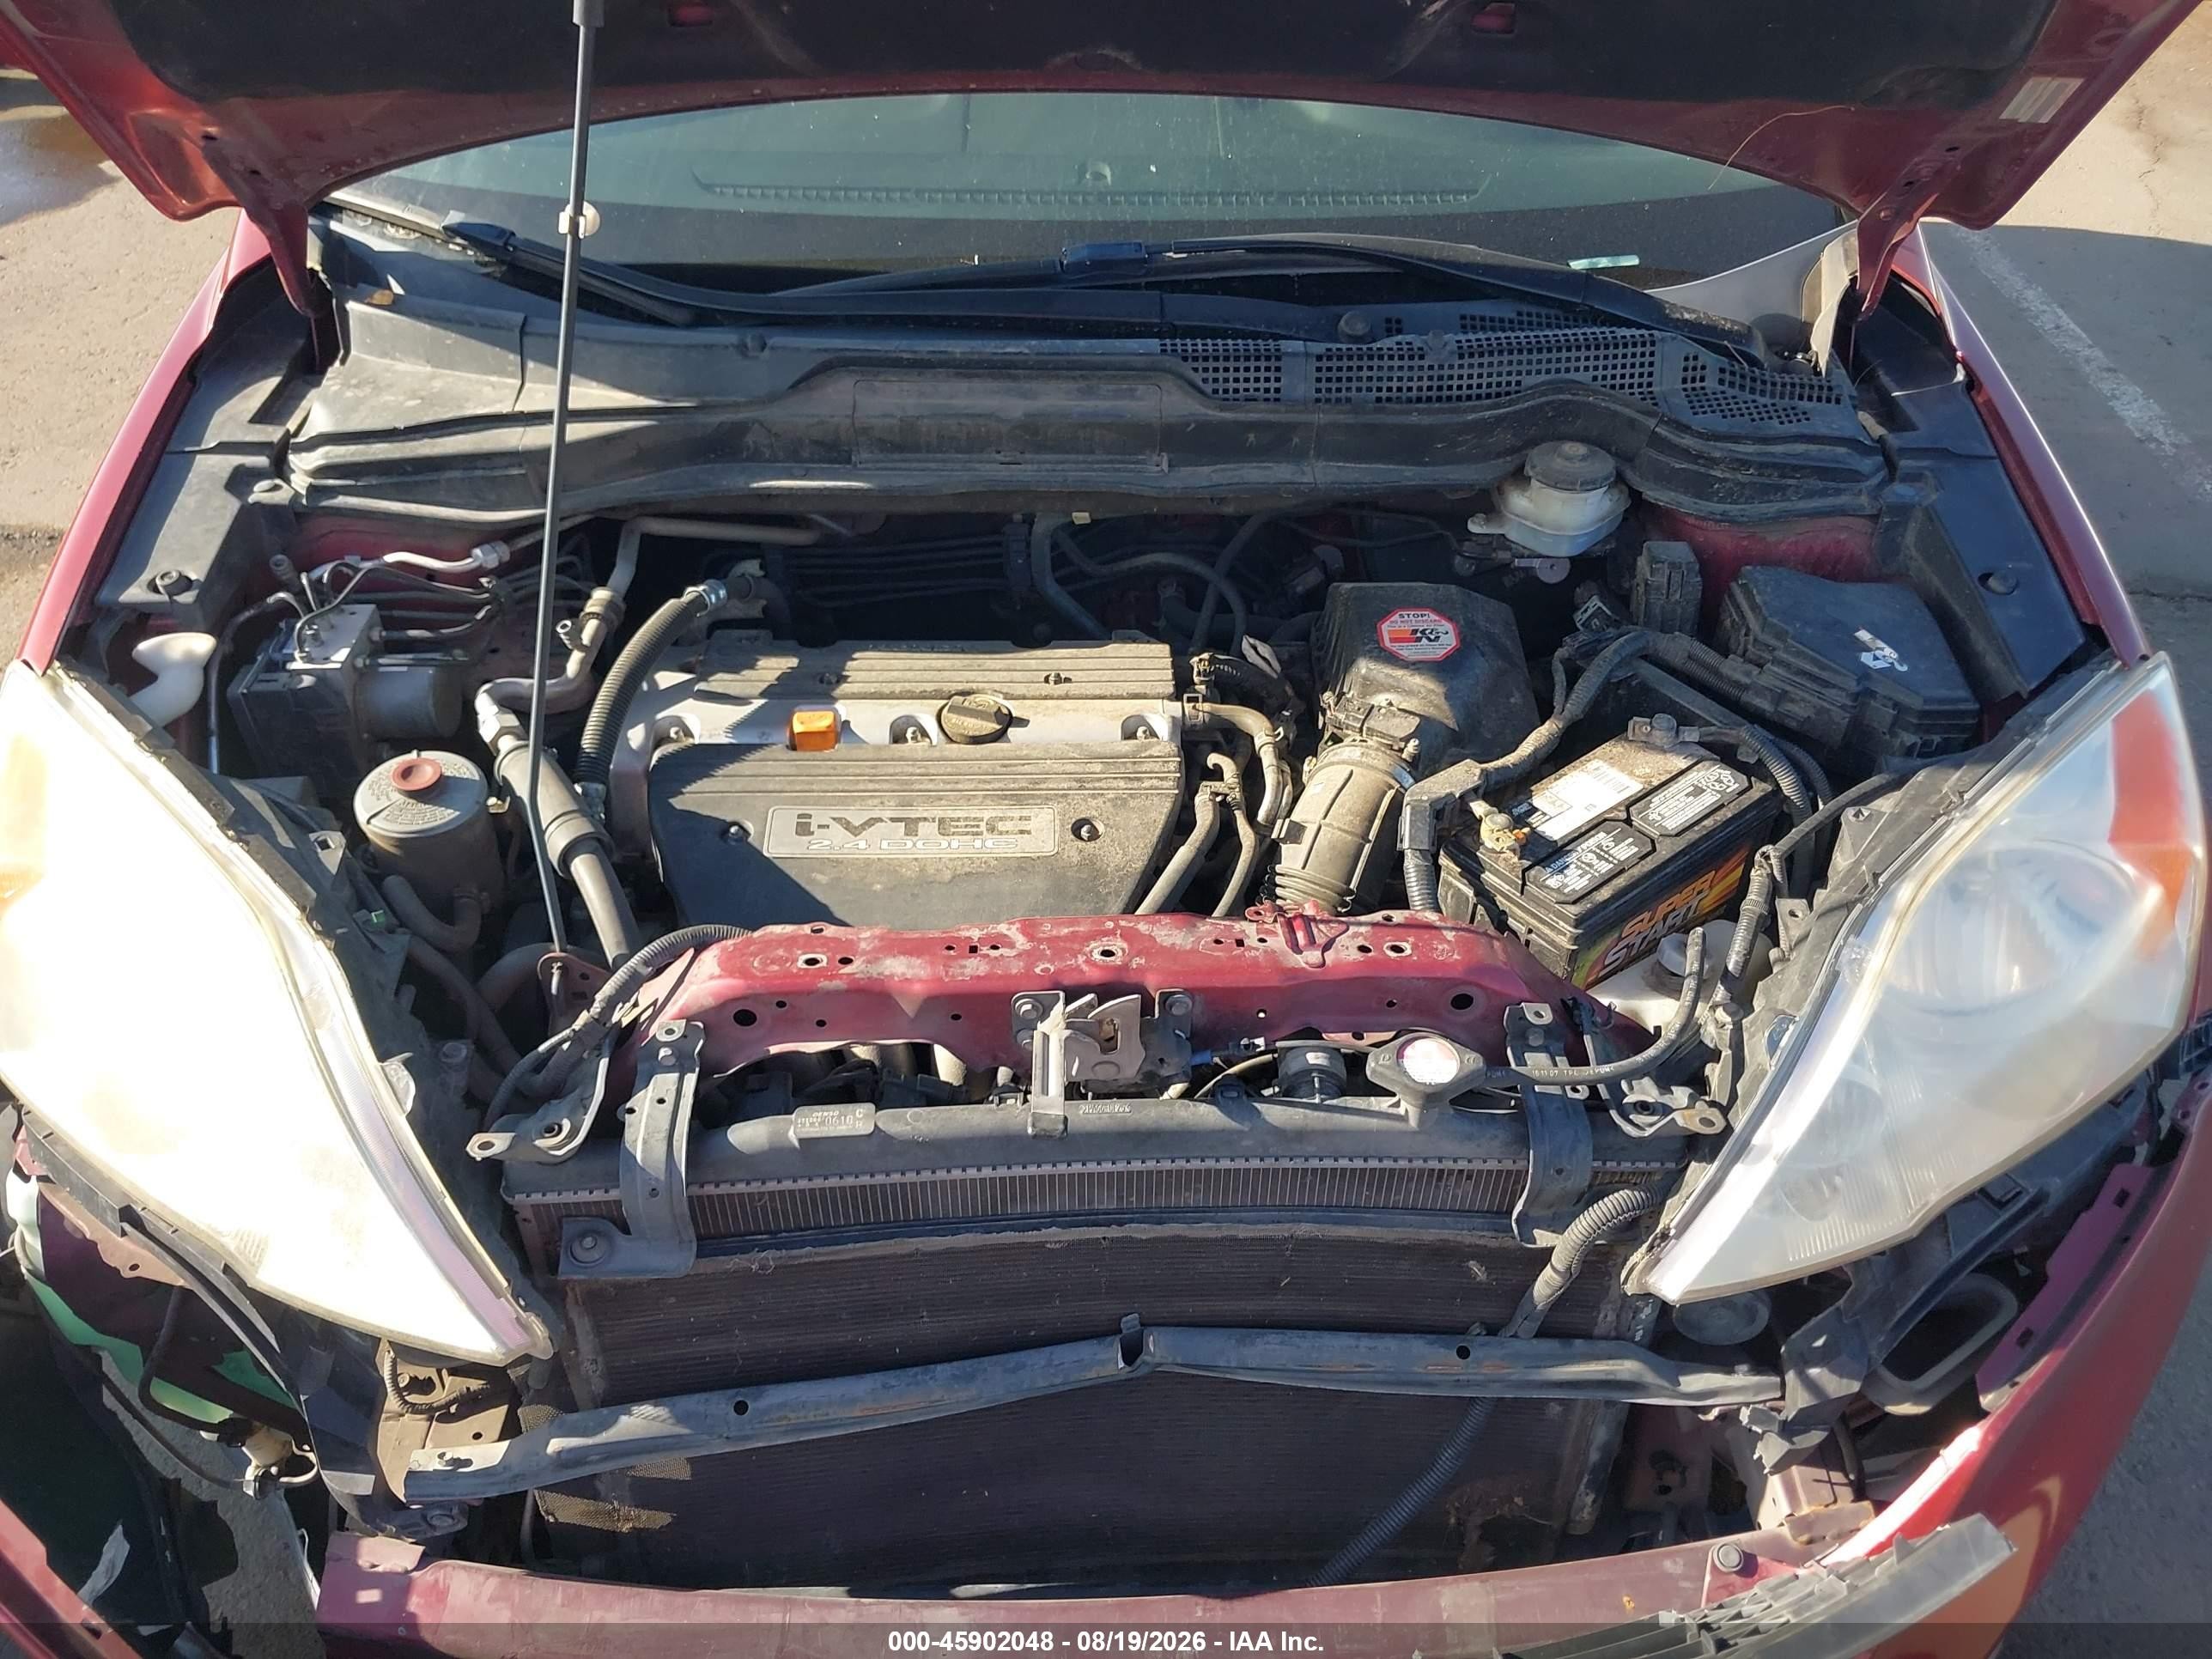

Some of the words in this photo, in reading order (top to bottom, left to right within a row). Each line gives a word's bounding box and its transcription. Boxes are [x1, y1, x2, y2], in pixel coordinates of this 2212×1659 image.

[795, 813, 1031, 837] i-VTEC
[808, 839, 869, 850] 2.4
[880, 838, 1018, 849] DOHC
[1621, 870, 1717, 939] SUPER
[1599, 886, 1711, 977] START
